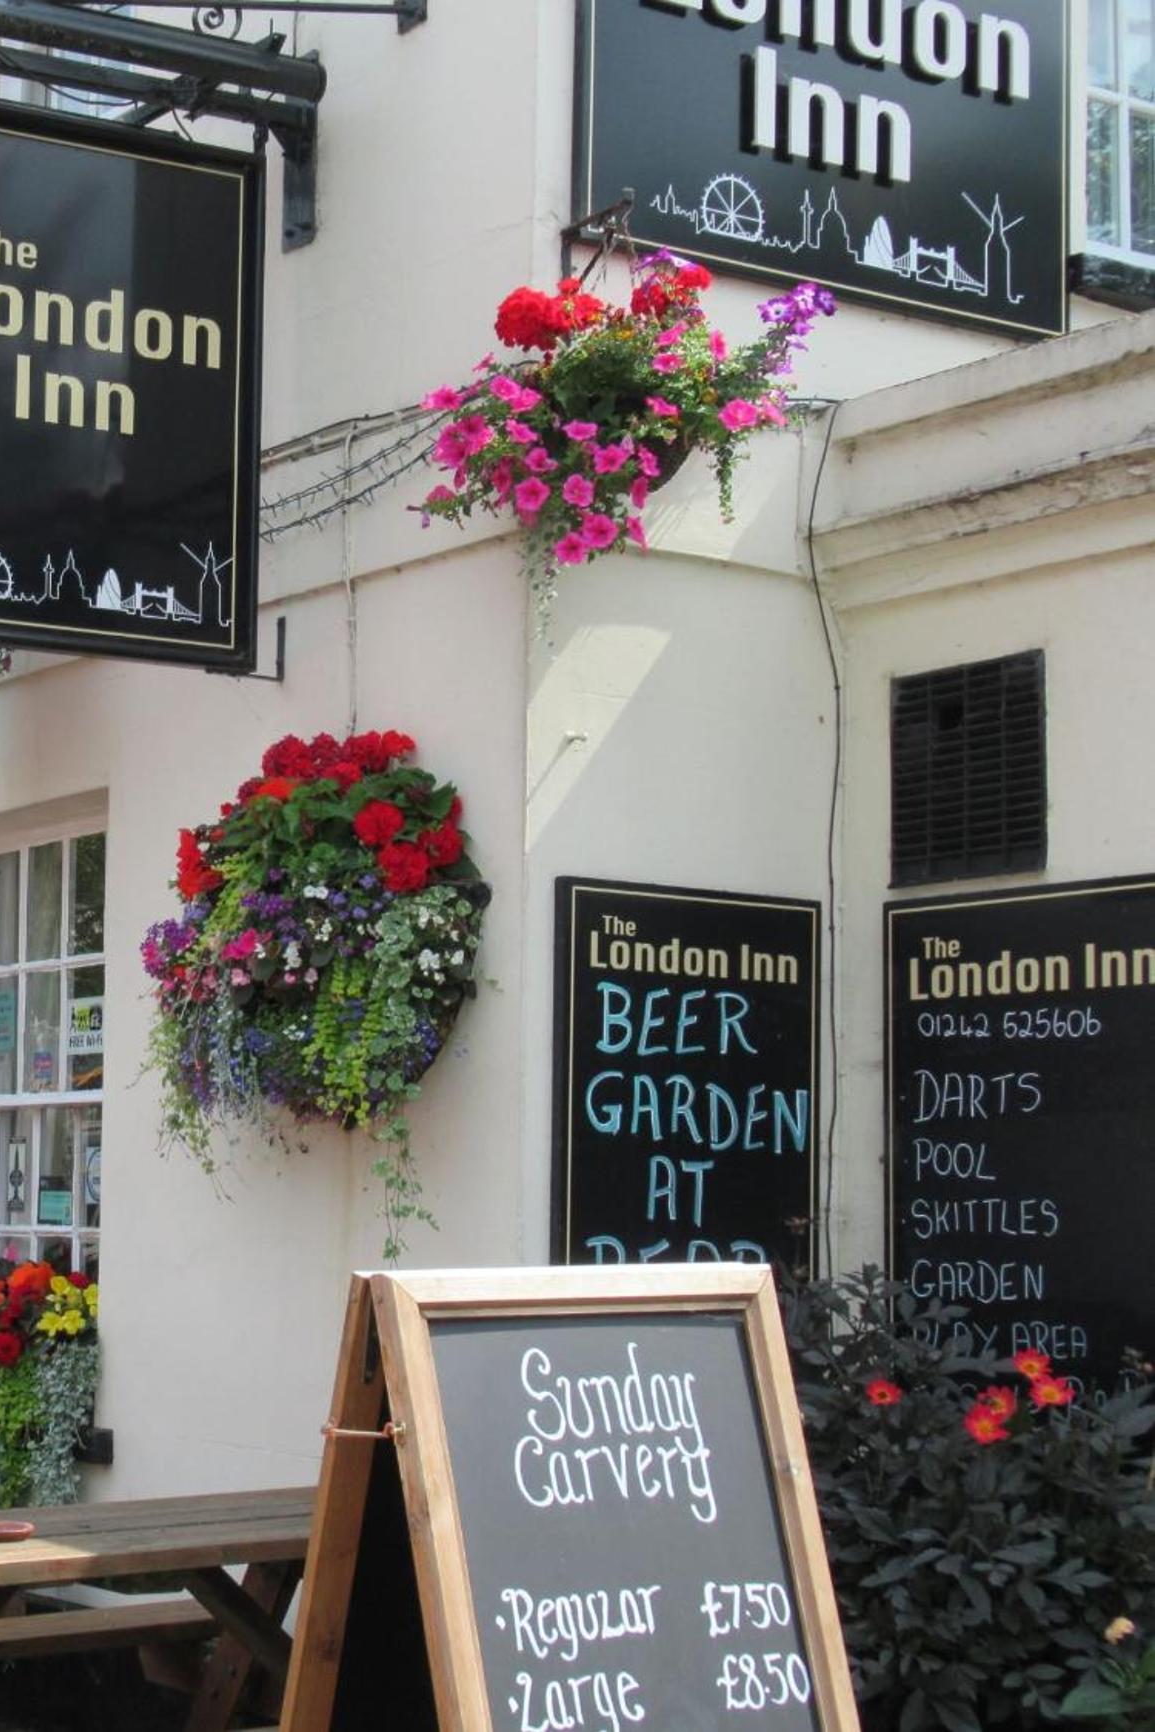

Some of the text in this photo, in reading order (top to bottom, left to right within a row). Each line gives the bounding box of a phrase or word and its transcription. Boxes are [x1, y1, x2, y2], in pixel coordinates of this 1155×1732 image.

[658, 0, 1031, 99] don
[754, 46, 912, 183] Inn
[14, 354, 136, 435] Inn
[602, 914, 637, 938] The
[922, 936, 961, 960] The
[589, 930, 799, 985] London Inn
[909, 943, 1155, 1001] London Inn
[595, 981, 758, 1056] BEER
[918, 1007, 1102, 1038] 01242 525606
[586, 1071, 808, 1154] GARDEN
[913, 1069, 1043, 1124] DARTS
[914, 1138, 996, 1182] POOL
[647, 1155, 715, 1227] AT
[911, 1198, 1060, 1239] SKITTLES
[911, 1258, 1044, 1304] GARDEN
[520, 1342, 703, 1457] Sunday
[514, 1436, 717, 1523] Carvery
[716, 1652, 811, 1710] £8.50
